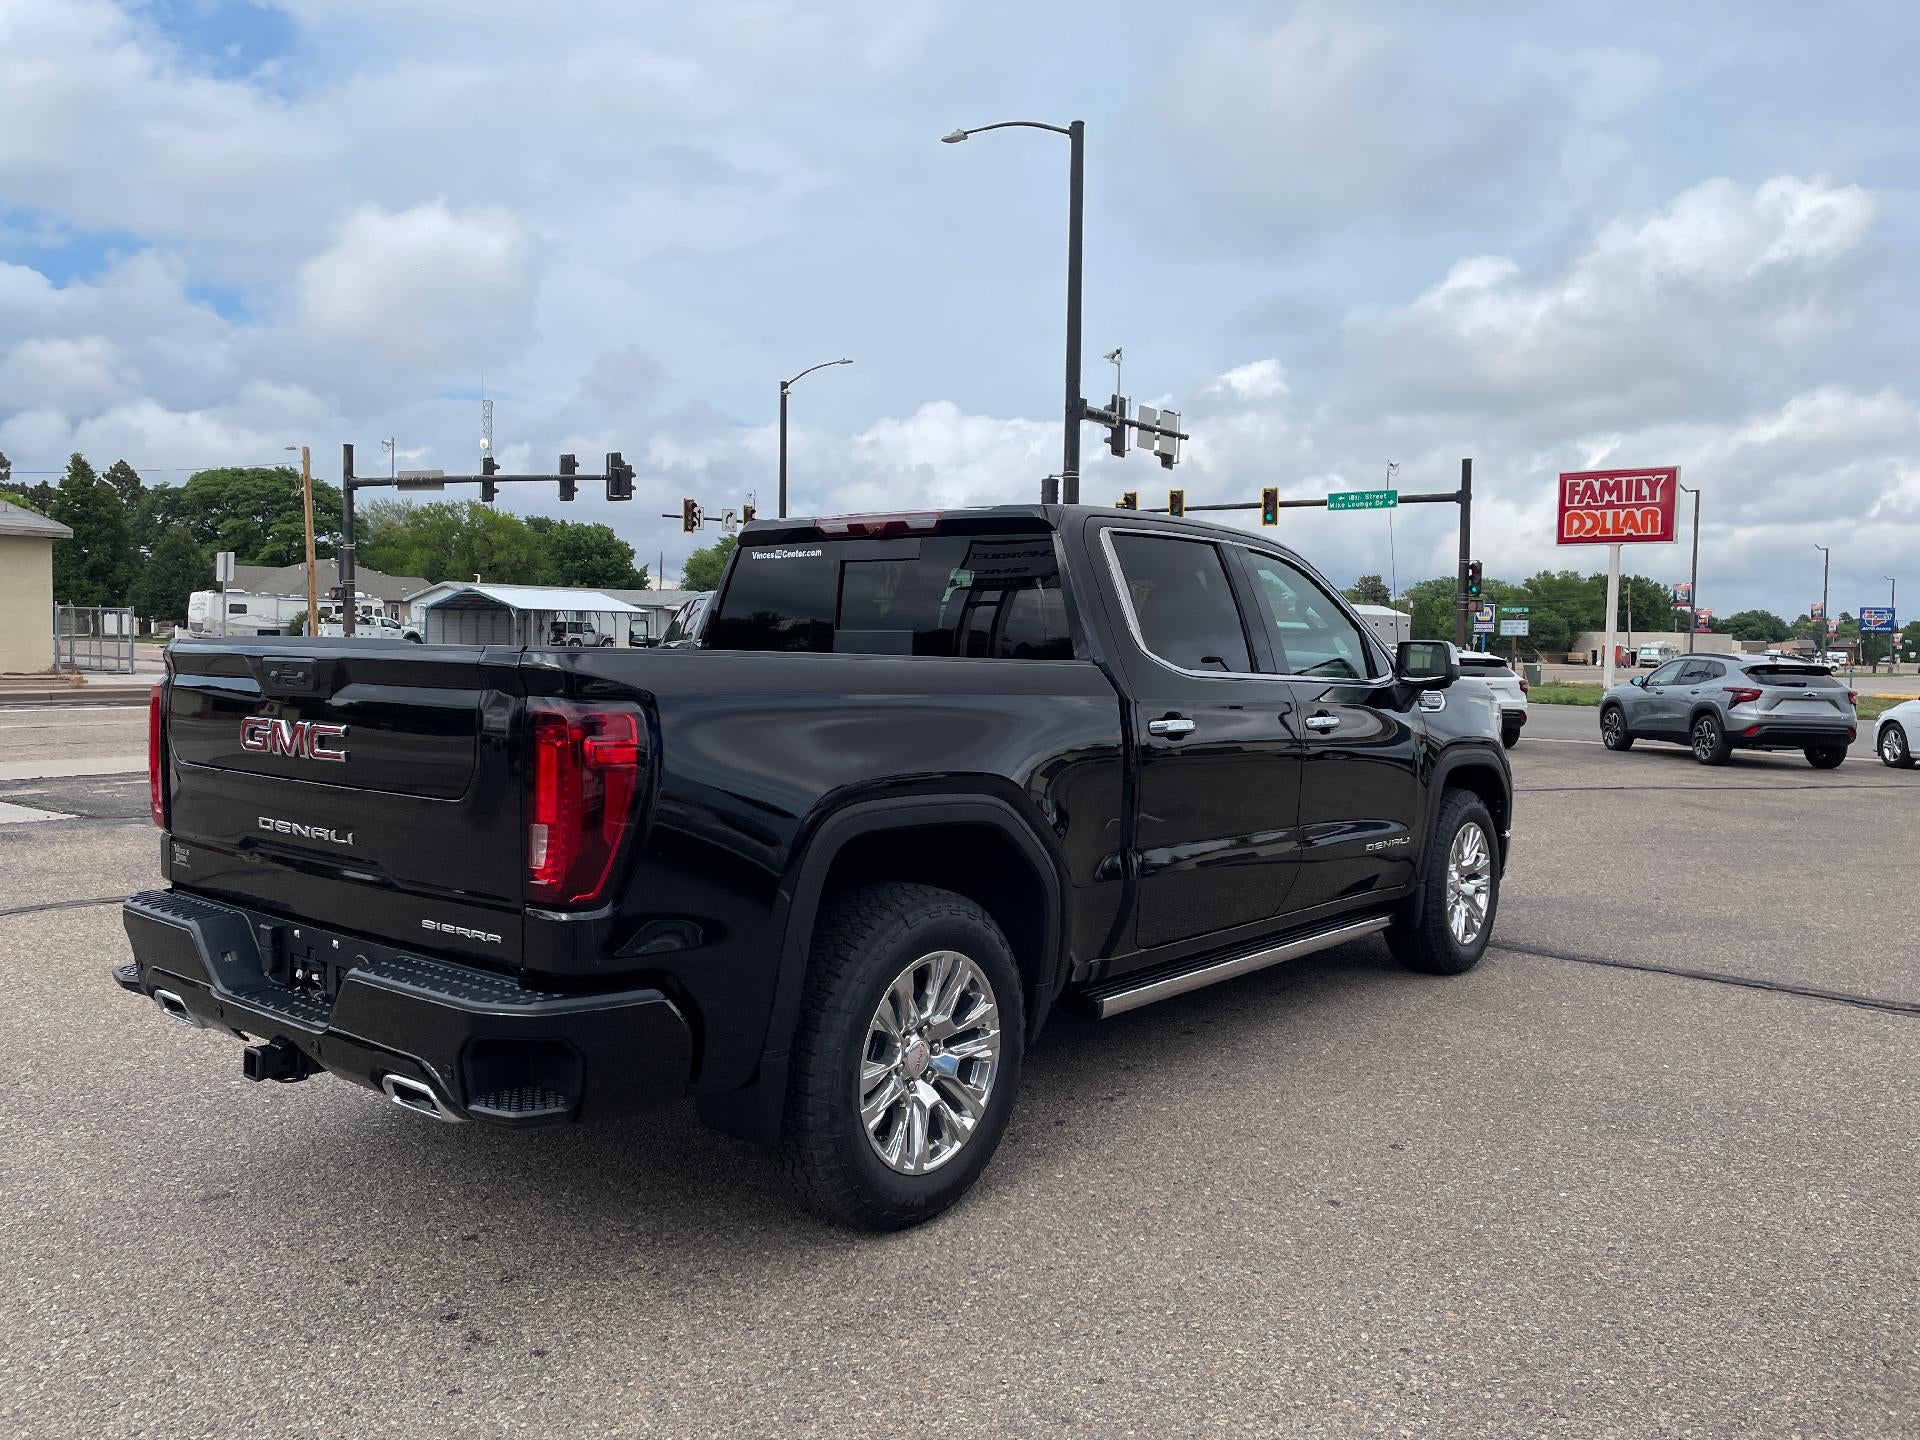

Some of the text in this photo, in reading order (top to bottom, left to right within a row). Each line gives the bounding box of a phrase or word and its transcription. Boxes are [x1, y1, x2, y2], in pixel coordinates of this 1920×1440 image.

[1565, 475, 1668, 506] FAMILY
[1564, 507, 1662, 538] DOLLAR
[240, 716, 347, 762] GMC
[258, 816, 354, 846] DENALI
[1365, 836, 1410, 852] DENALI
[421, 919, 502, 944] SIERRA
